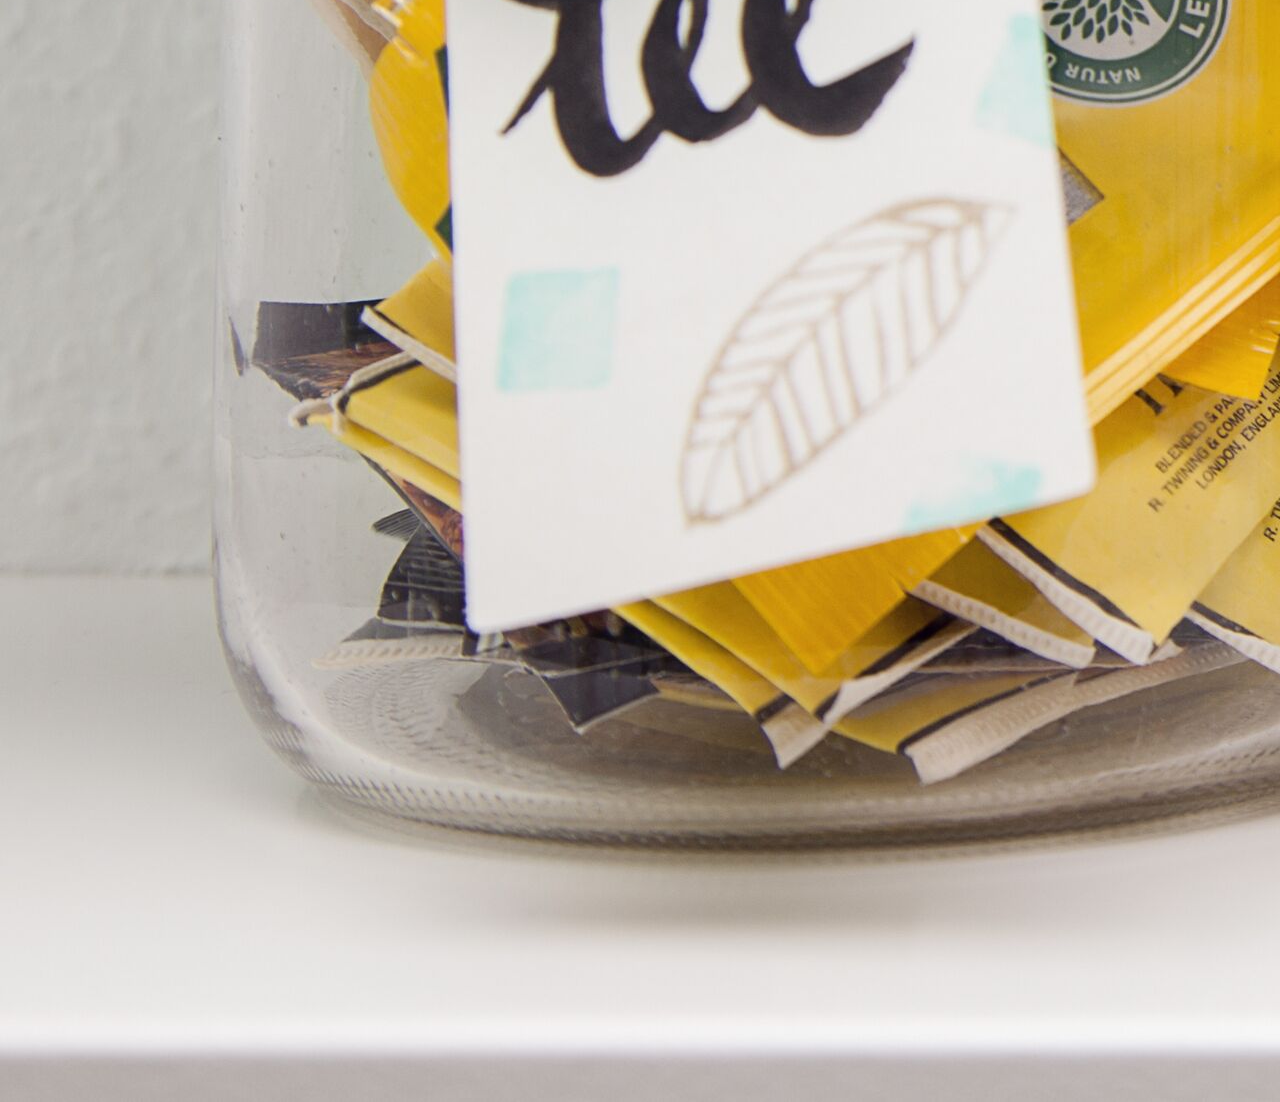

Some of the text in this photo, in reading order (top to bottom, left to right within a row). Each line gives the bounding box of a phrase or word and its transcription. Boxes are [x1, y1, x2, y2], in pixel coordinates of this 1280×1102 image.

[1065, 61, 1141, 84] NATUR
[1154, 396, 1238, 474] BLENDED & PA
[1162, 446, 1210, 496] TWINING
[1208, 437, 1220, 450] &
[1216, 392, 1268, 439] COMPAY
[1195, 440, 1246, 490] LONDON,
[1263, 526, 1279, 542] R.
